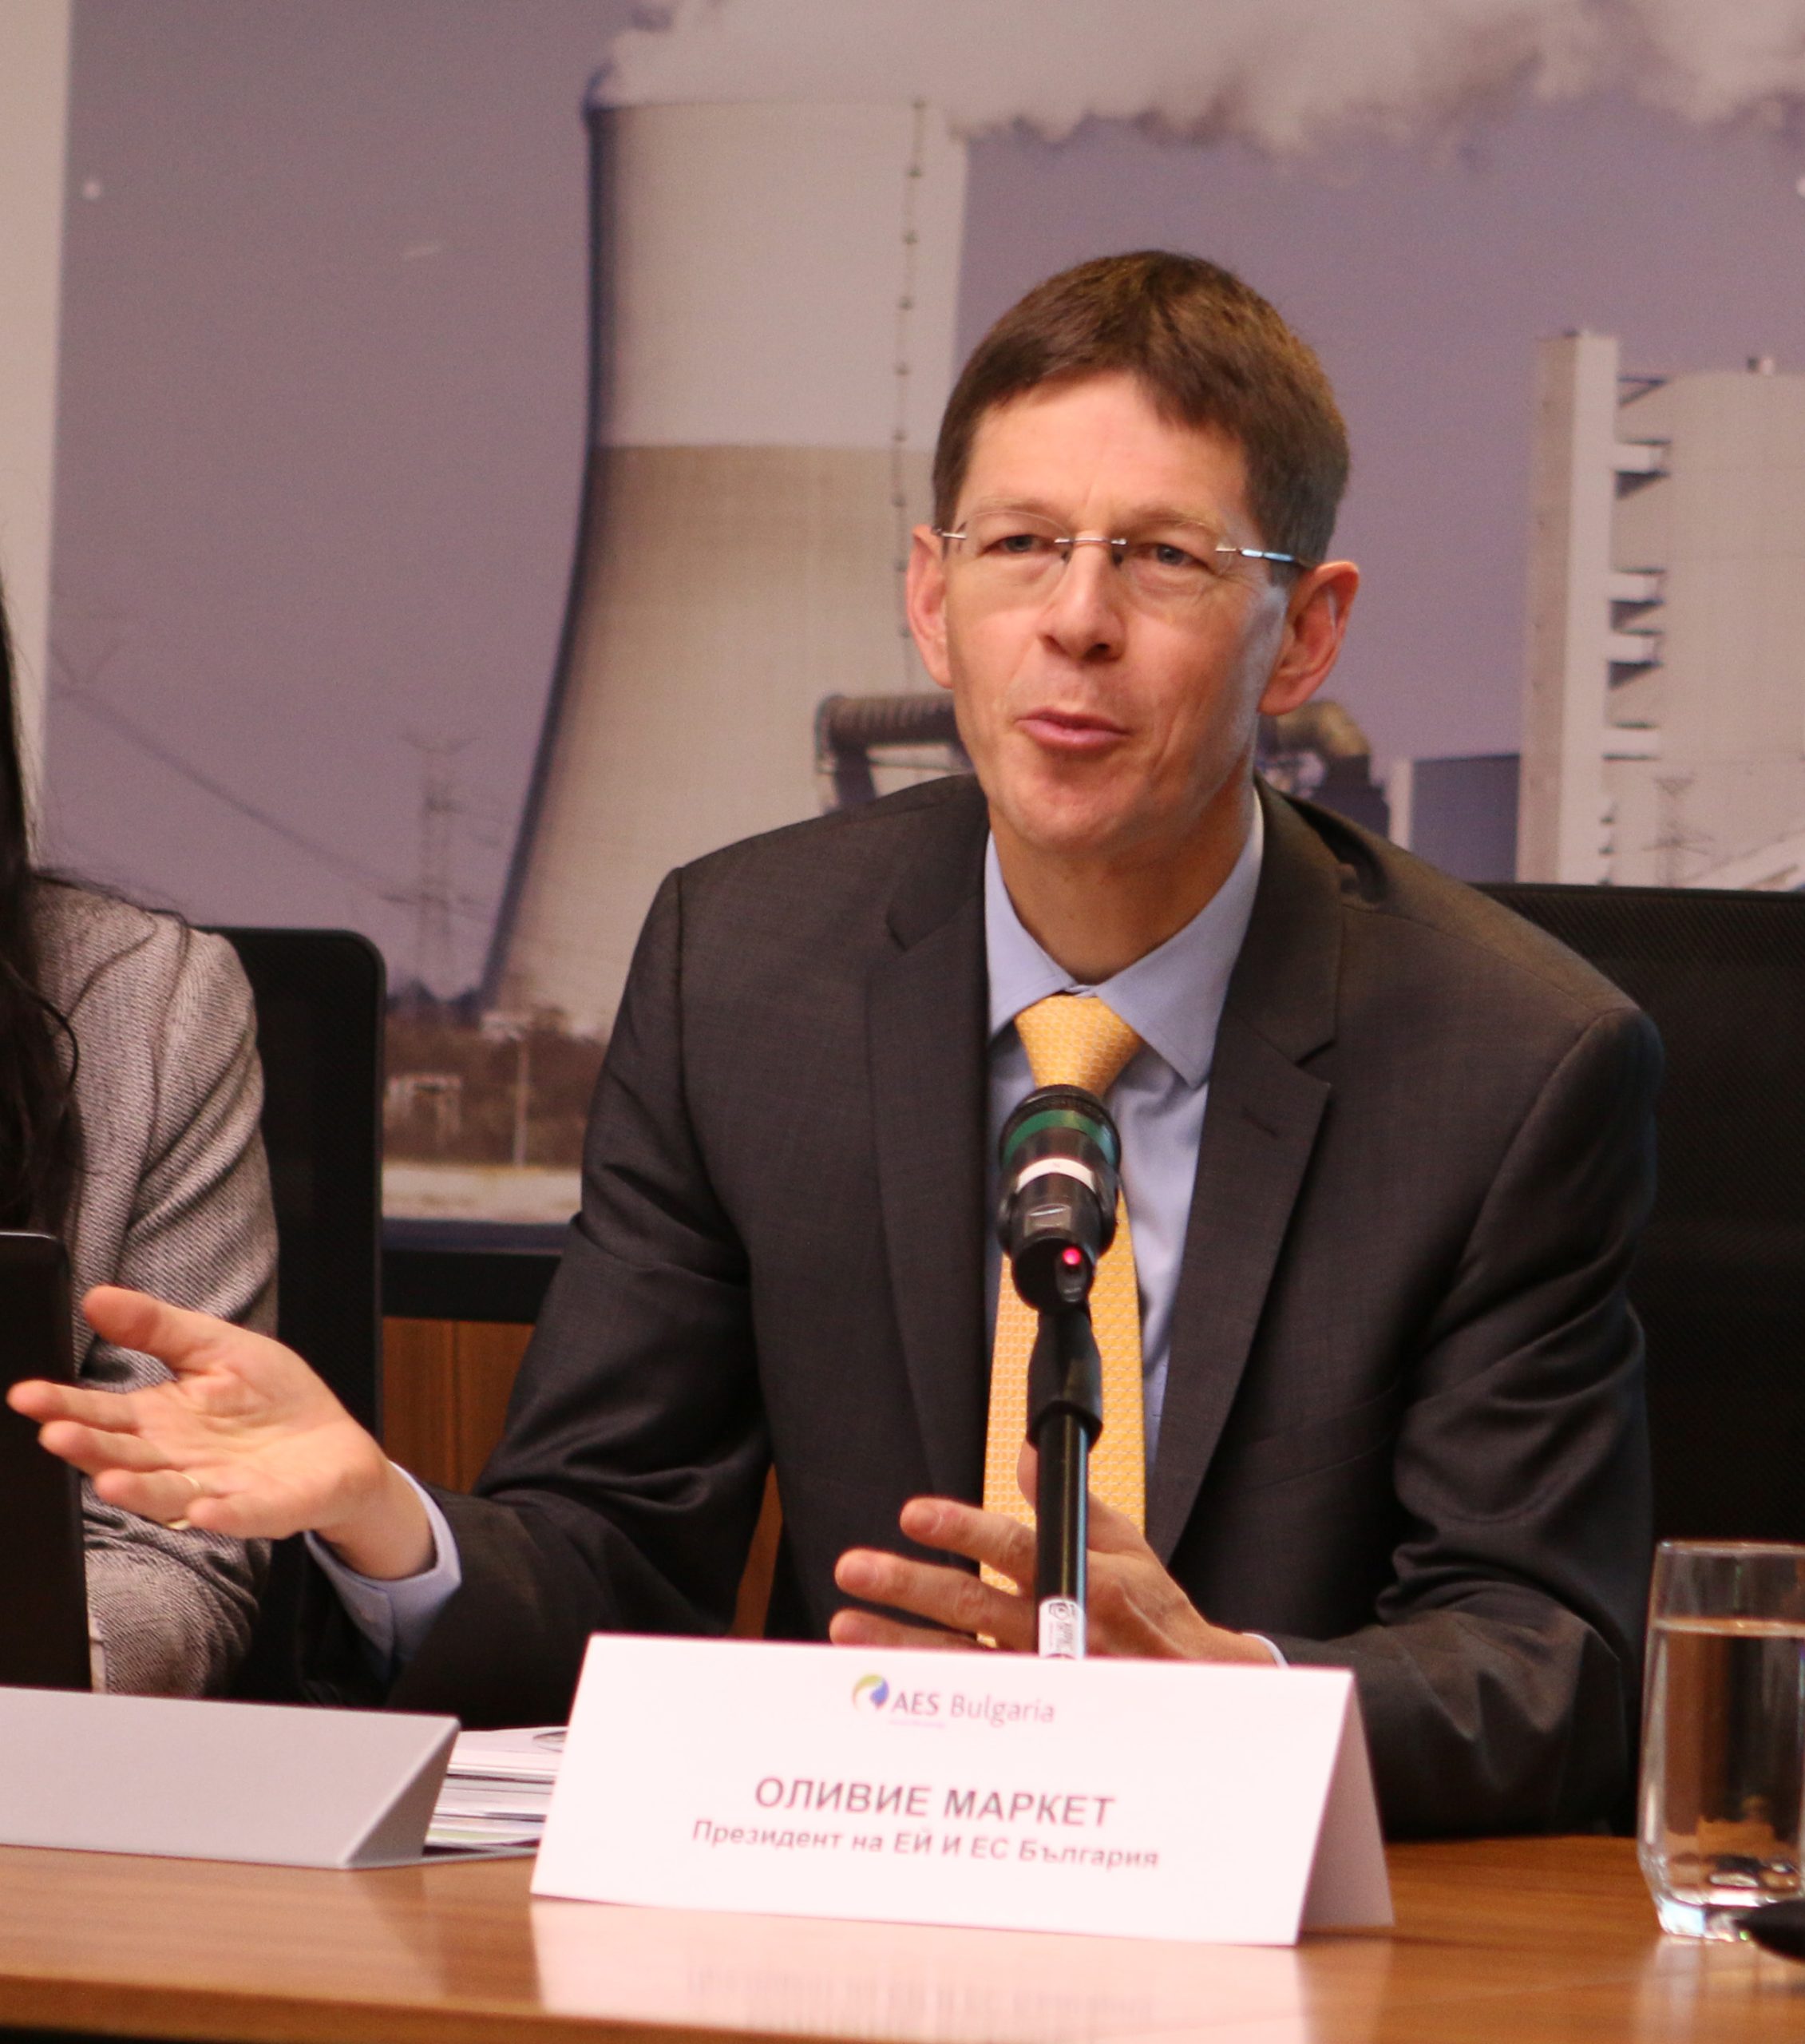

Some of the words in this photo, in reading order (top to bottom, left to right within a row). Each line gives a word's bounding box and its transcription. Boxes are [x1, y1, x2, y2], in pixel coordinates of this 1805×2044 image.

[891, 1691, 940, 1716] AES
[950, 1693, 1055, 1728] Bulgaria
[755, 1777, 932, 1816] ОЛИВИЕ
[943, 1788, 1116, 1827] МАРКЕТ
[691, 1819, 843, 1849] Президент
[852, 1834, 883, 1852] на
[893, 1825, 932, 1854] ЕЙ
[941, 1834, 962, 1856] И
[970, 1836, 1009, 1860] ЕС
[1018, 1839, 1159, 1871] България
